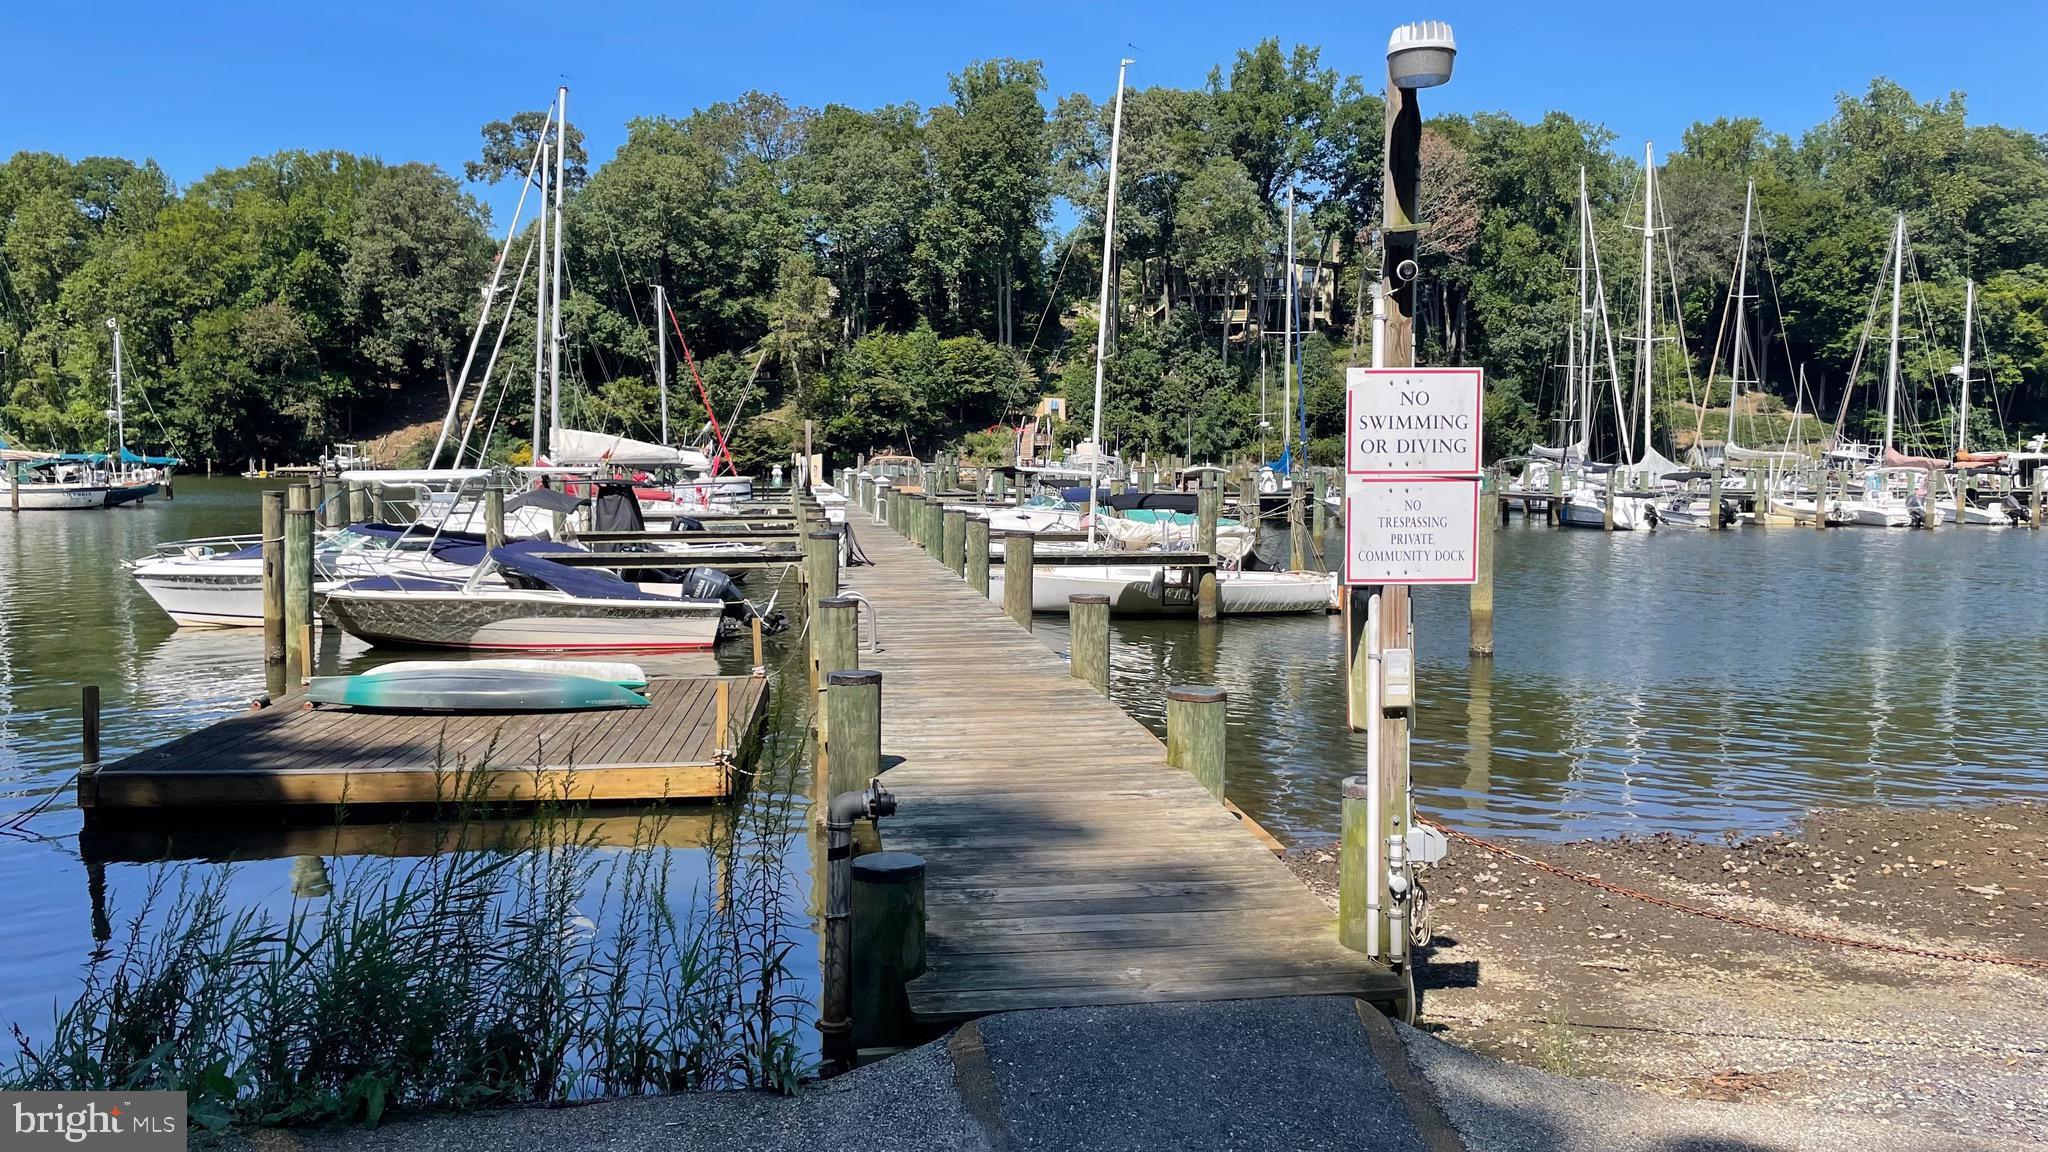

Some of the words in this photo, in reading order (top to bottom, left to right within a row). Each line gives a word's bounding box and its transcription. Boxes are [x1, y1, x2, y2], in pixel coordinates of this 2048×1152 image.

[1399, 391, 1430, 406] NO
[1359, 414, 1469, 430] SWIMMING
[1360, 438, 1389, 454] OR
[1396, 438, 1468, 454] DIVING
[1404, 499, 1422, 512] NO
[1377, 515, 1448, 529] TRESPASSING
[1390, 532, 1434, 545] PRIVATE
[1357, 550, 1431, 562] COMMUNITY
[1434, 549, 1466, 562] DOCK
